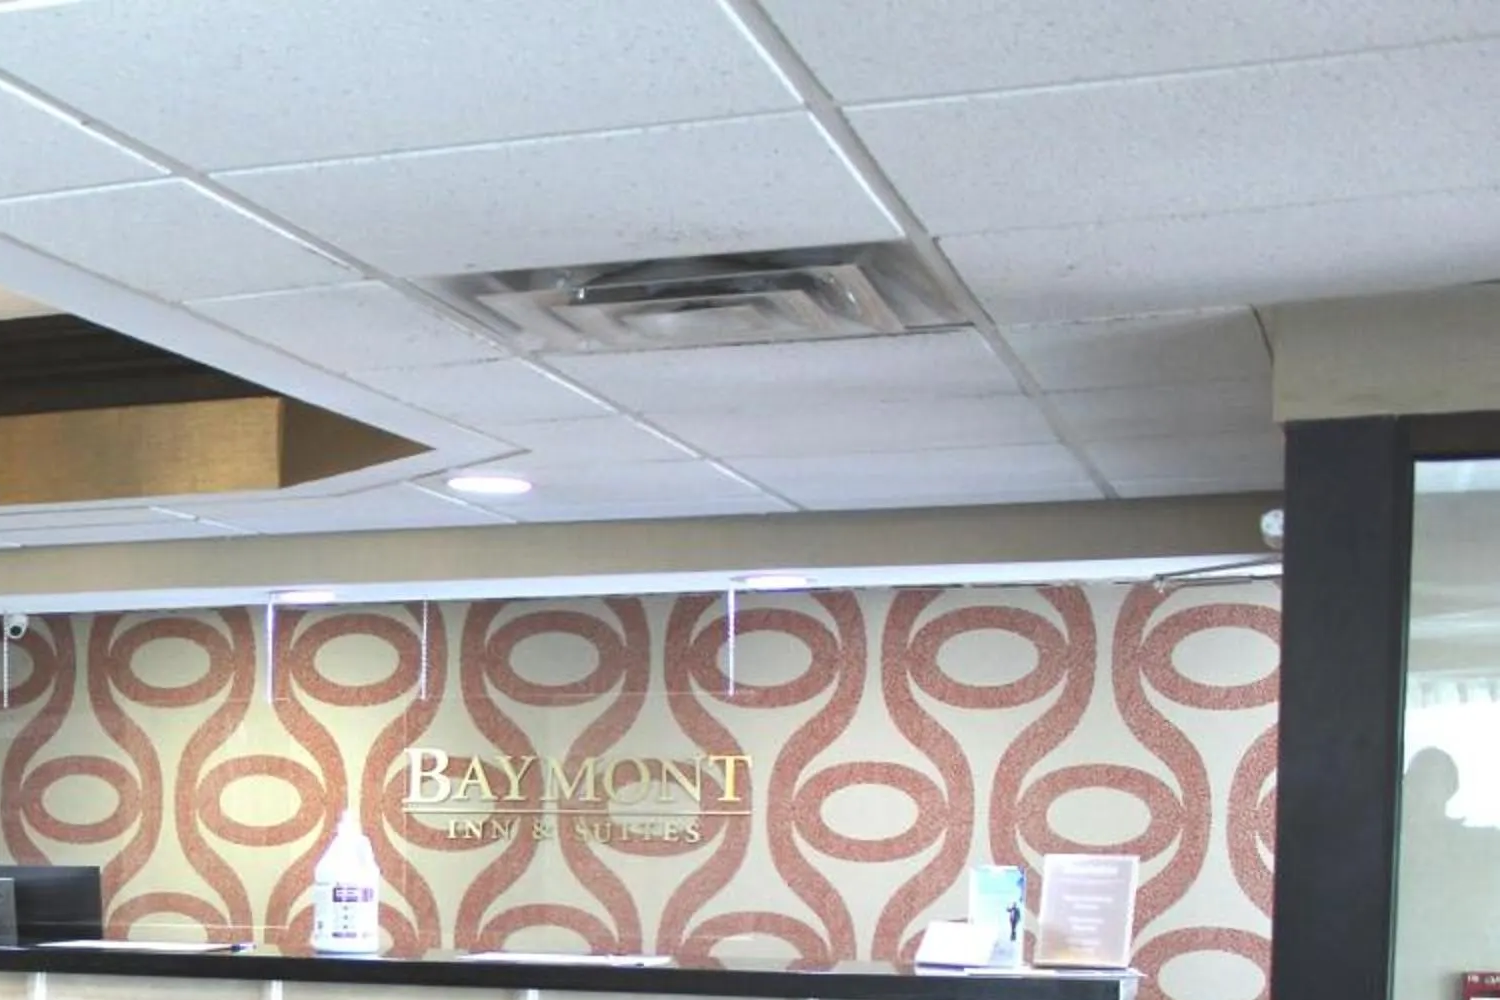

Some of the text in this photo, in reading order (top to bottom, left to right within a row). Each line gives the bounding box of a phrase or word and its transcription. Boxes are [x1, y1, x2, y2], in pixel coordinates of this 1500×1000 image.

[402, 748, 753, 803] BAYMONT
[447, 819, 700, 843] INN & SUITES
